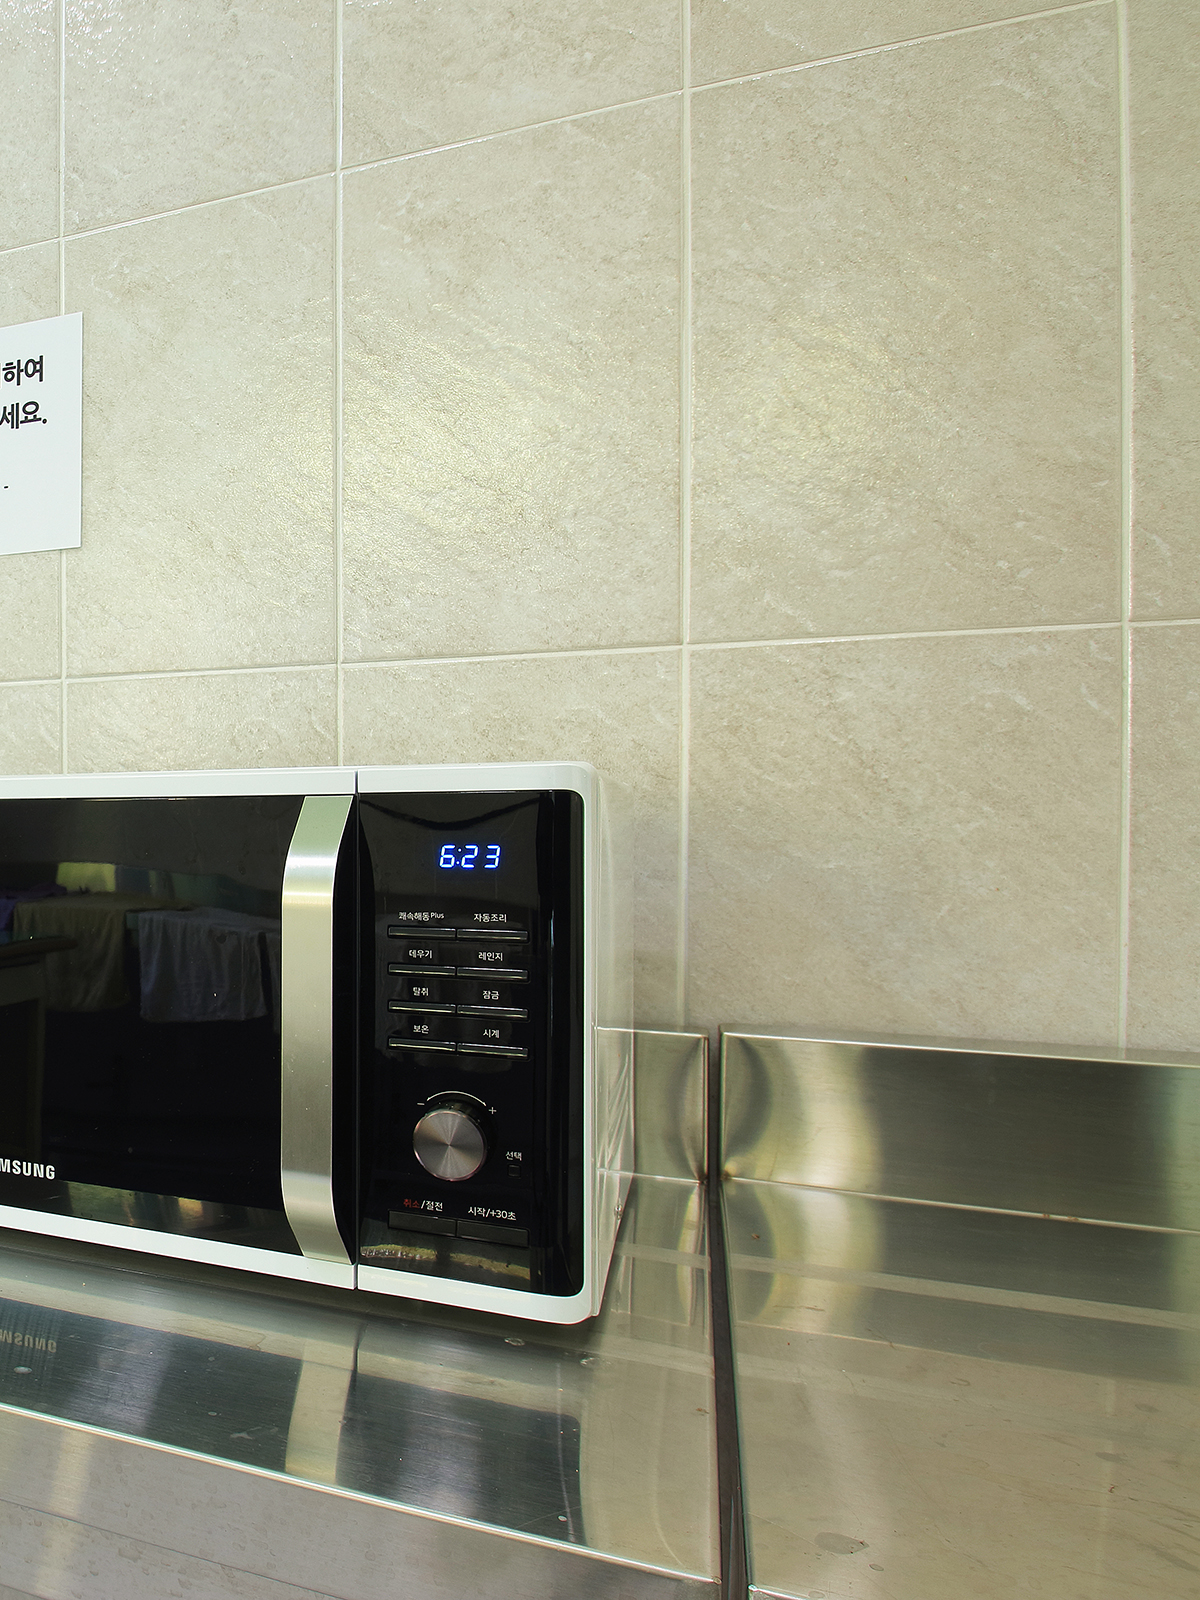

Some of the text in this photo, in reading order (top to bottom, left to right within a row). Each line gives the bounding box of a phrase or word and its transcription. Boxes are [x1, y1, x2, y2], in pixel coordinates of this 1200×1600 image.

[439, 844, 501, 869] 6:23
[473, 913, 507, 923] 자동조리
[408, 949, 433, 959] 데우기
[478, 951, 503, 962] 레인지
[482, 990, 500, 1000] 잠금
[412, 1024, 430, 1034] 보온
[482, 1028, 500, 1039] 시계
[505, 1151, 522, 1161] 선택
[467, 1206, 517, 1221] 시작/+30초
